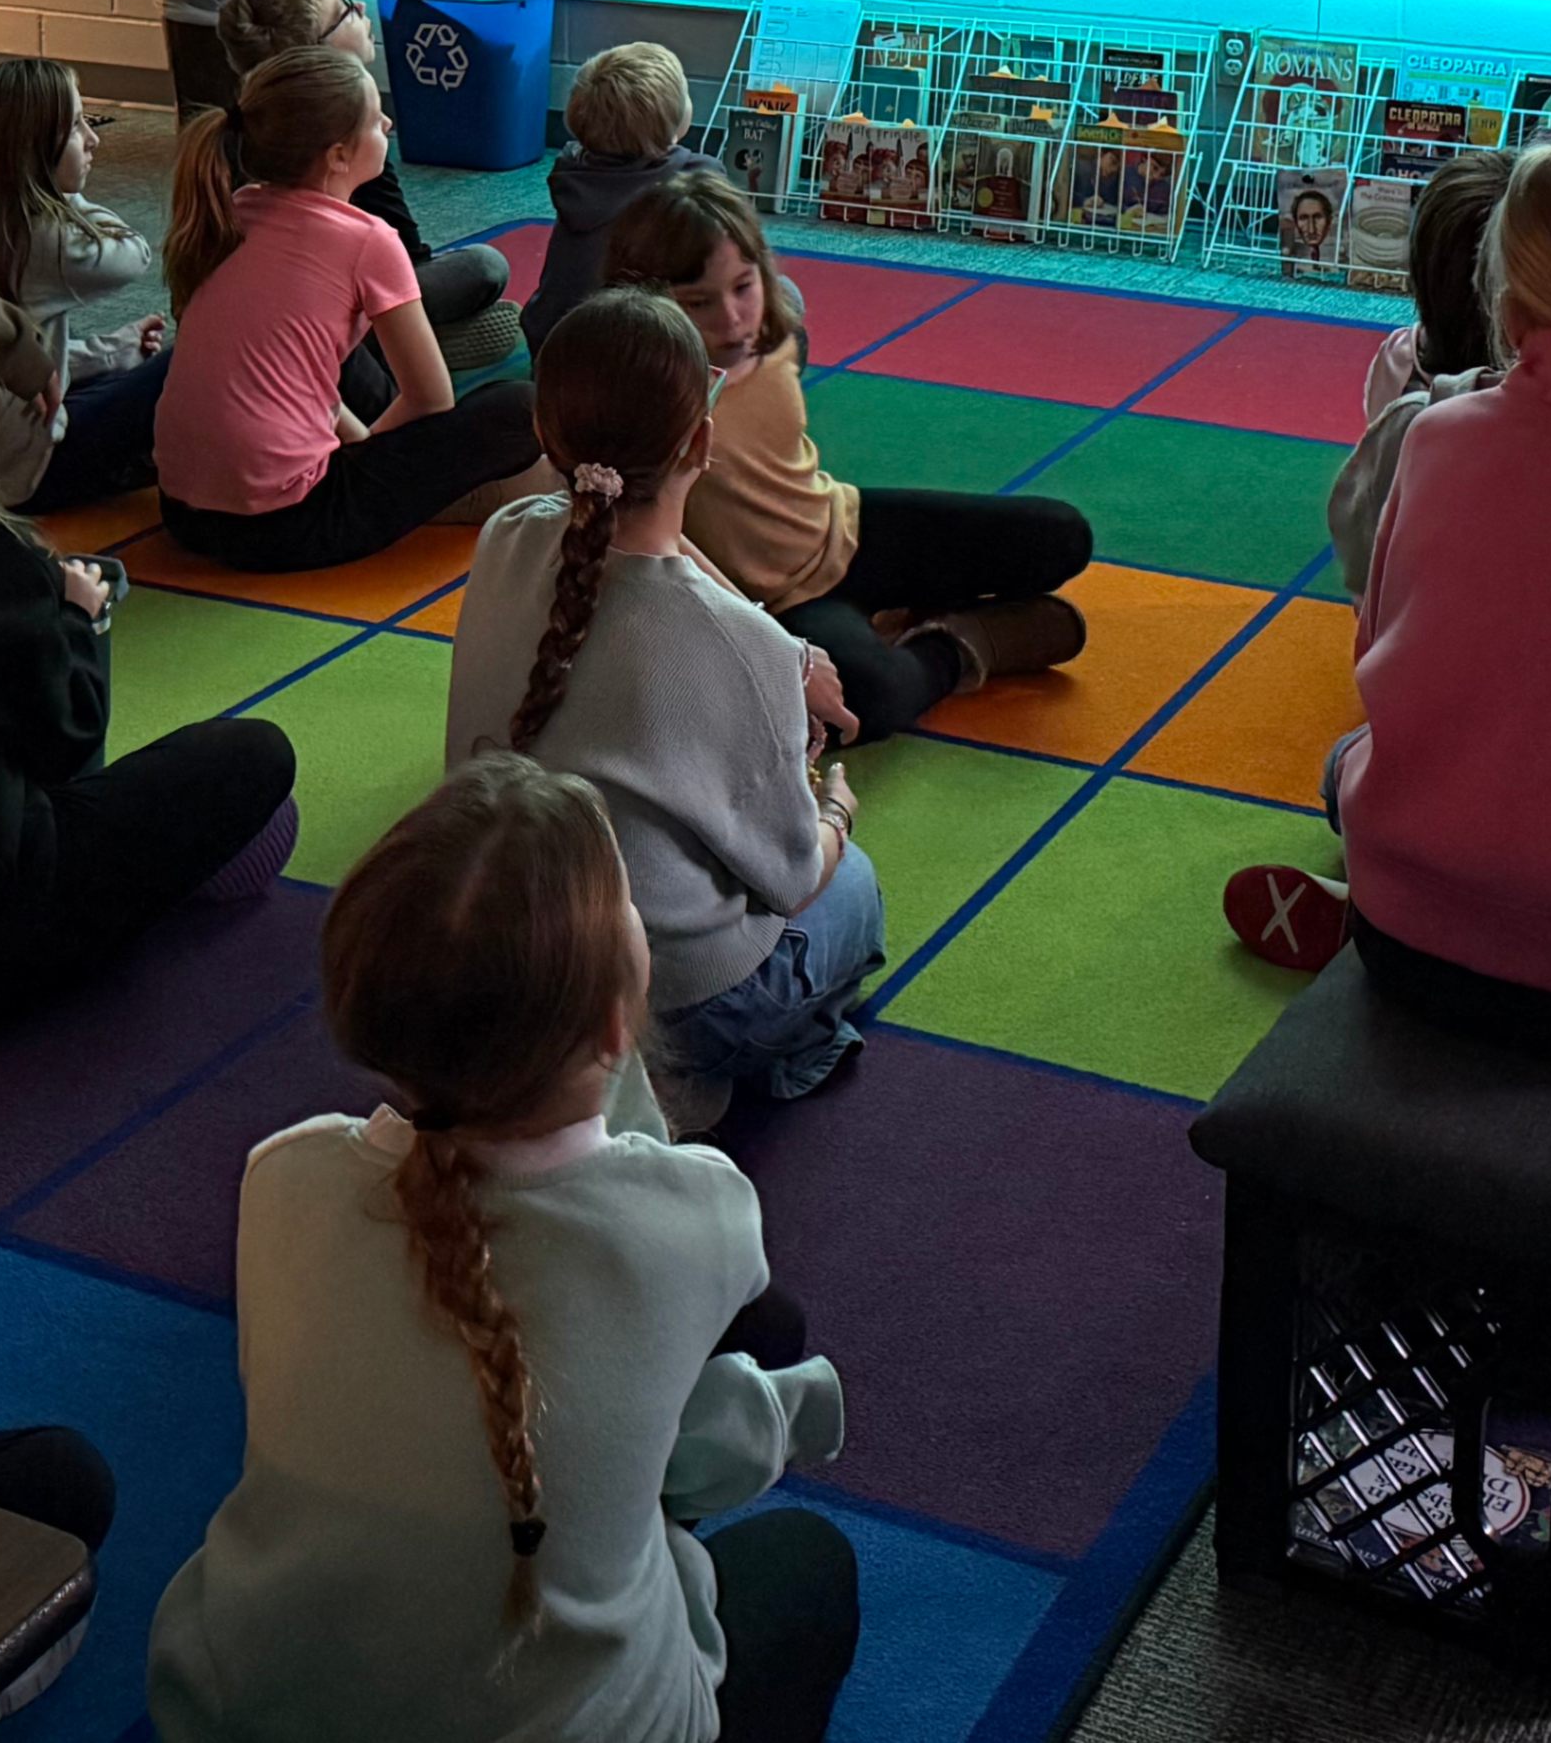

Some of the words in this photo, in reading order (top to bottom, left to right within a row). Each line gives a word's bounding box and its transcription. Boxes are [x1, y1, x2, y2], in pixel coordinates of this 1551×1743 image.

[1262, 50, 1353, 82] ROMANS
[1407, 53, 1508, 78] CLEOPATRA
[1389, 107, 1462, 124] CLEOPATRA
